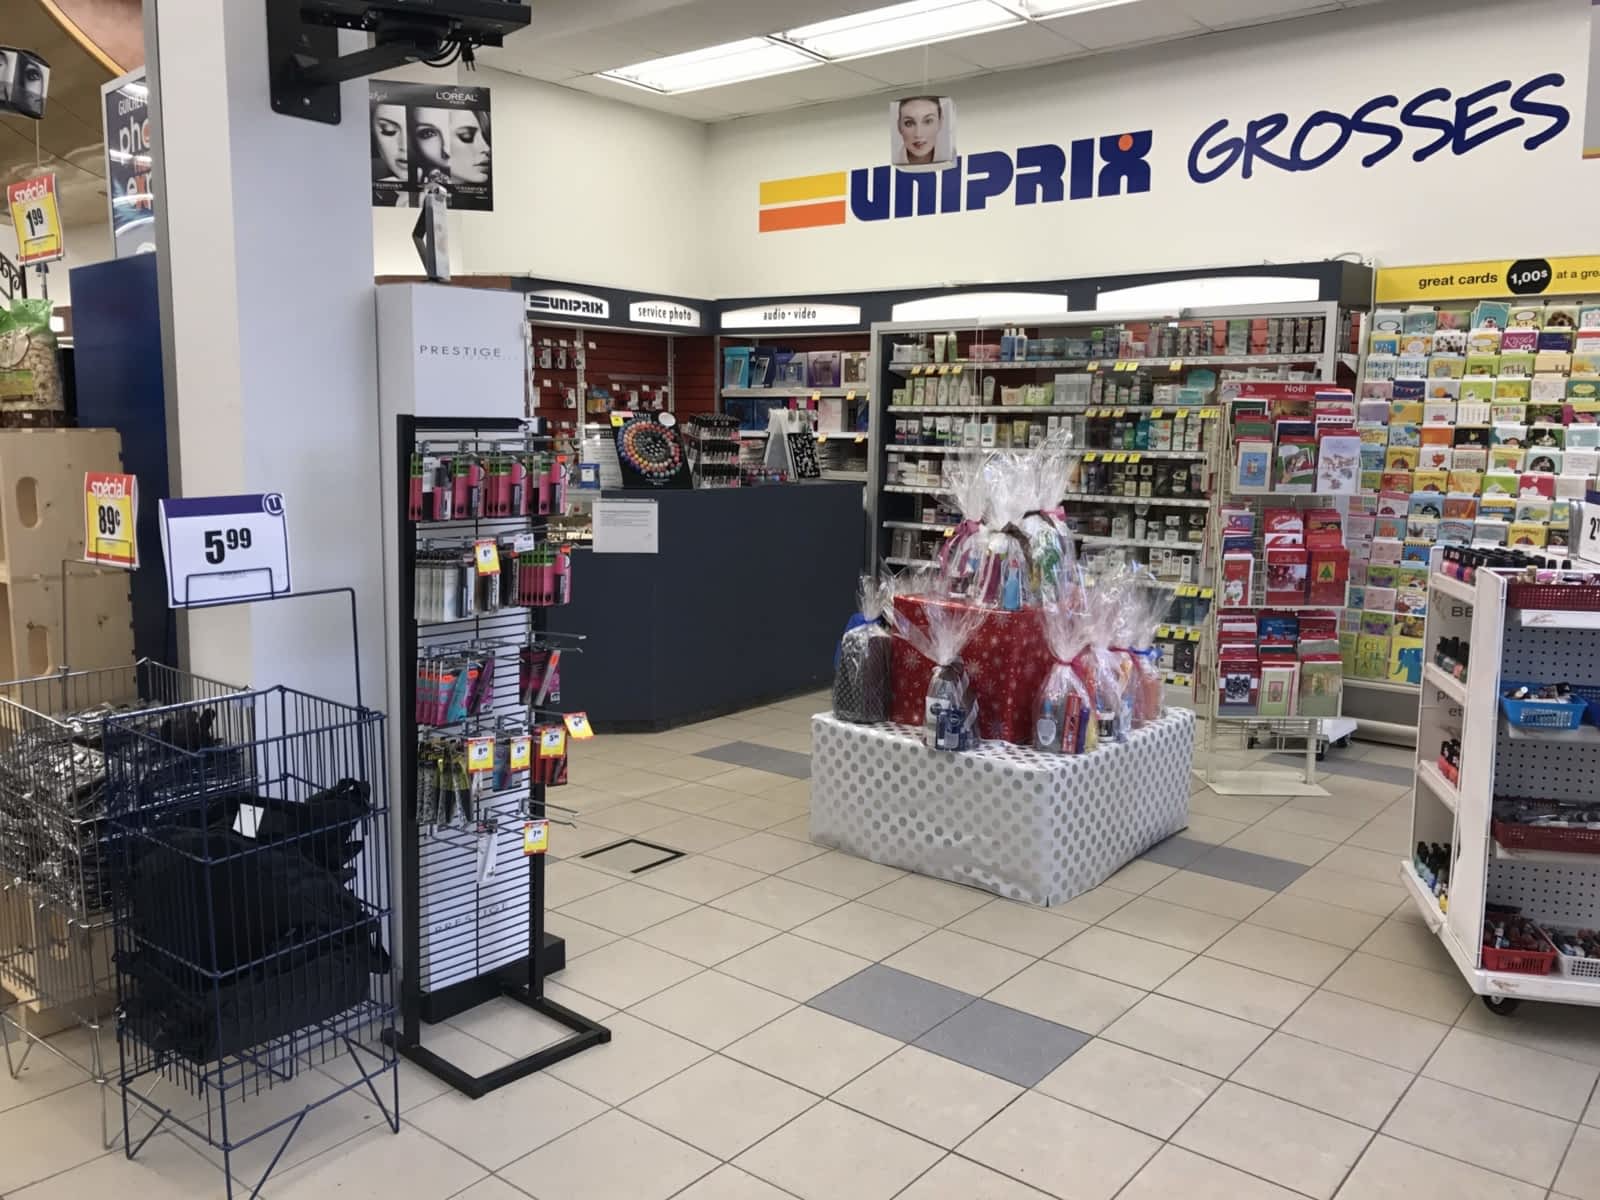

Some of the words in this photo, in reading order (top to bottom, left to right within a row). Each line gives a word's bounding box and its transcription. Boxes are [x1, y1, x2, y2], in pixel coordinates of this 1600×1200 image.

[1187, 73, 1570, 184] GROSSES
[850, 129, 1153, 222] UNIPRIX
[14, 177, 48, 204] spécial
[1418, 274, 1454, 290] great
[1458, 272, 1498, 285] cards
[1556, 270, 1567, 280] at
[1570, 271, 1578, 279] a
[1581, 269, 1600, 283] gre
[550, 297, 604, 315] UNIPRIX
[638, 306, 667, 319] service
[669, 306, 692, 322] photo
[763, 308, 786, 321] audio
[793, 307, 817, 320] video
[419, 344, 502, 358] PRESTIGE
[1284, 384, 1307, 393] Noël
[91, 477, 127, 499] spécial
